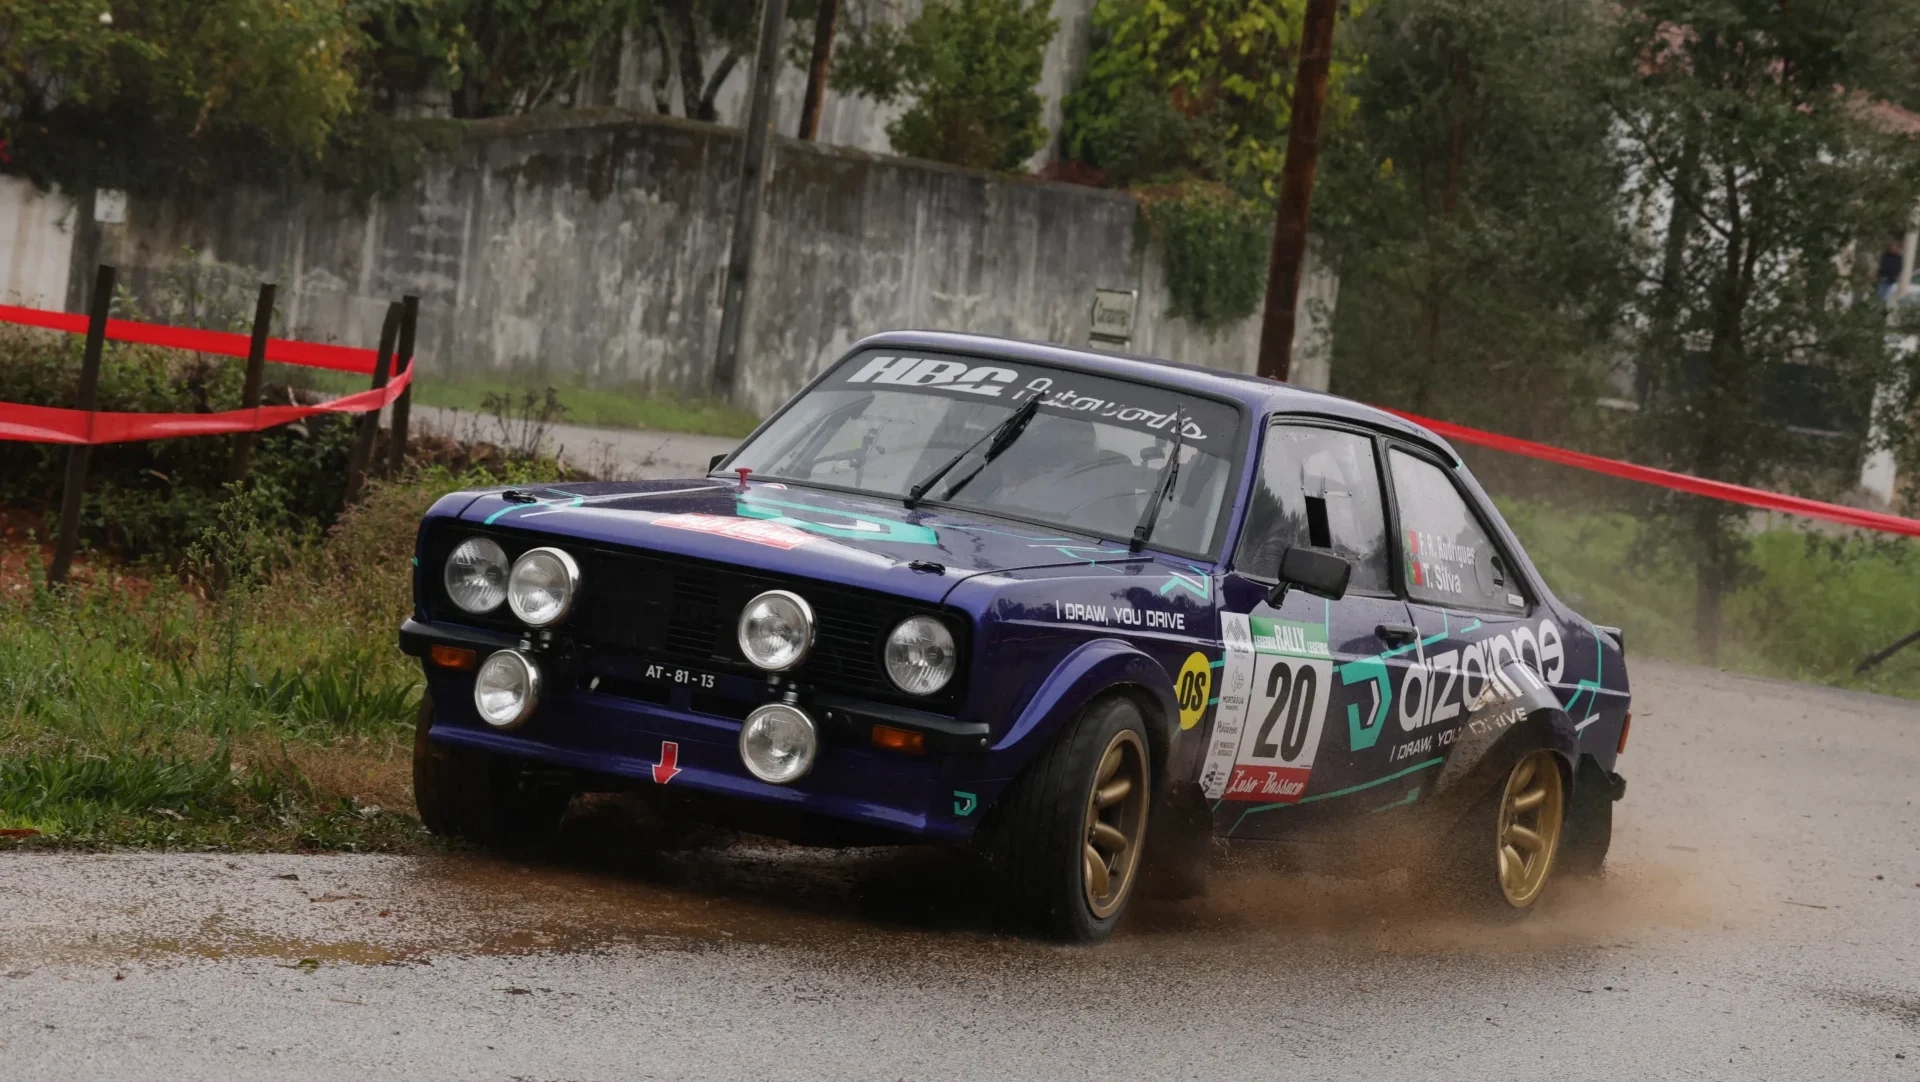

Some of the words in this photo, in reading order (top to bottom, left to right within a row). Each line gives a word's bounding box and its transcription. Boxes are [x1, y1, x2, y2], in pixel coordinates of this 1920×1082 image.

[1437, 536, 1475, 568] Rodrigues
[1423, 562, 1434, 589] T.
[1434, 563, 1461, 594] Silva
[1055, 599, 1061, 620] I
[1065, 603, 1109, 626] DRAW,
[1113, 607, 1142, 626] YOU
[1146, 610, 1186, 630] DRIVE
[1274, 624, 1306, 652] RALLY
[1179, 670, 1206, 712] OS
[1252, 661, 1317, 763] 20
[1389, 745, 1396, 763] I
[1397, 735, 1433, 760] DRAW,
[1469, 707, 1528, 735] DRIVE
